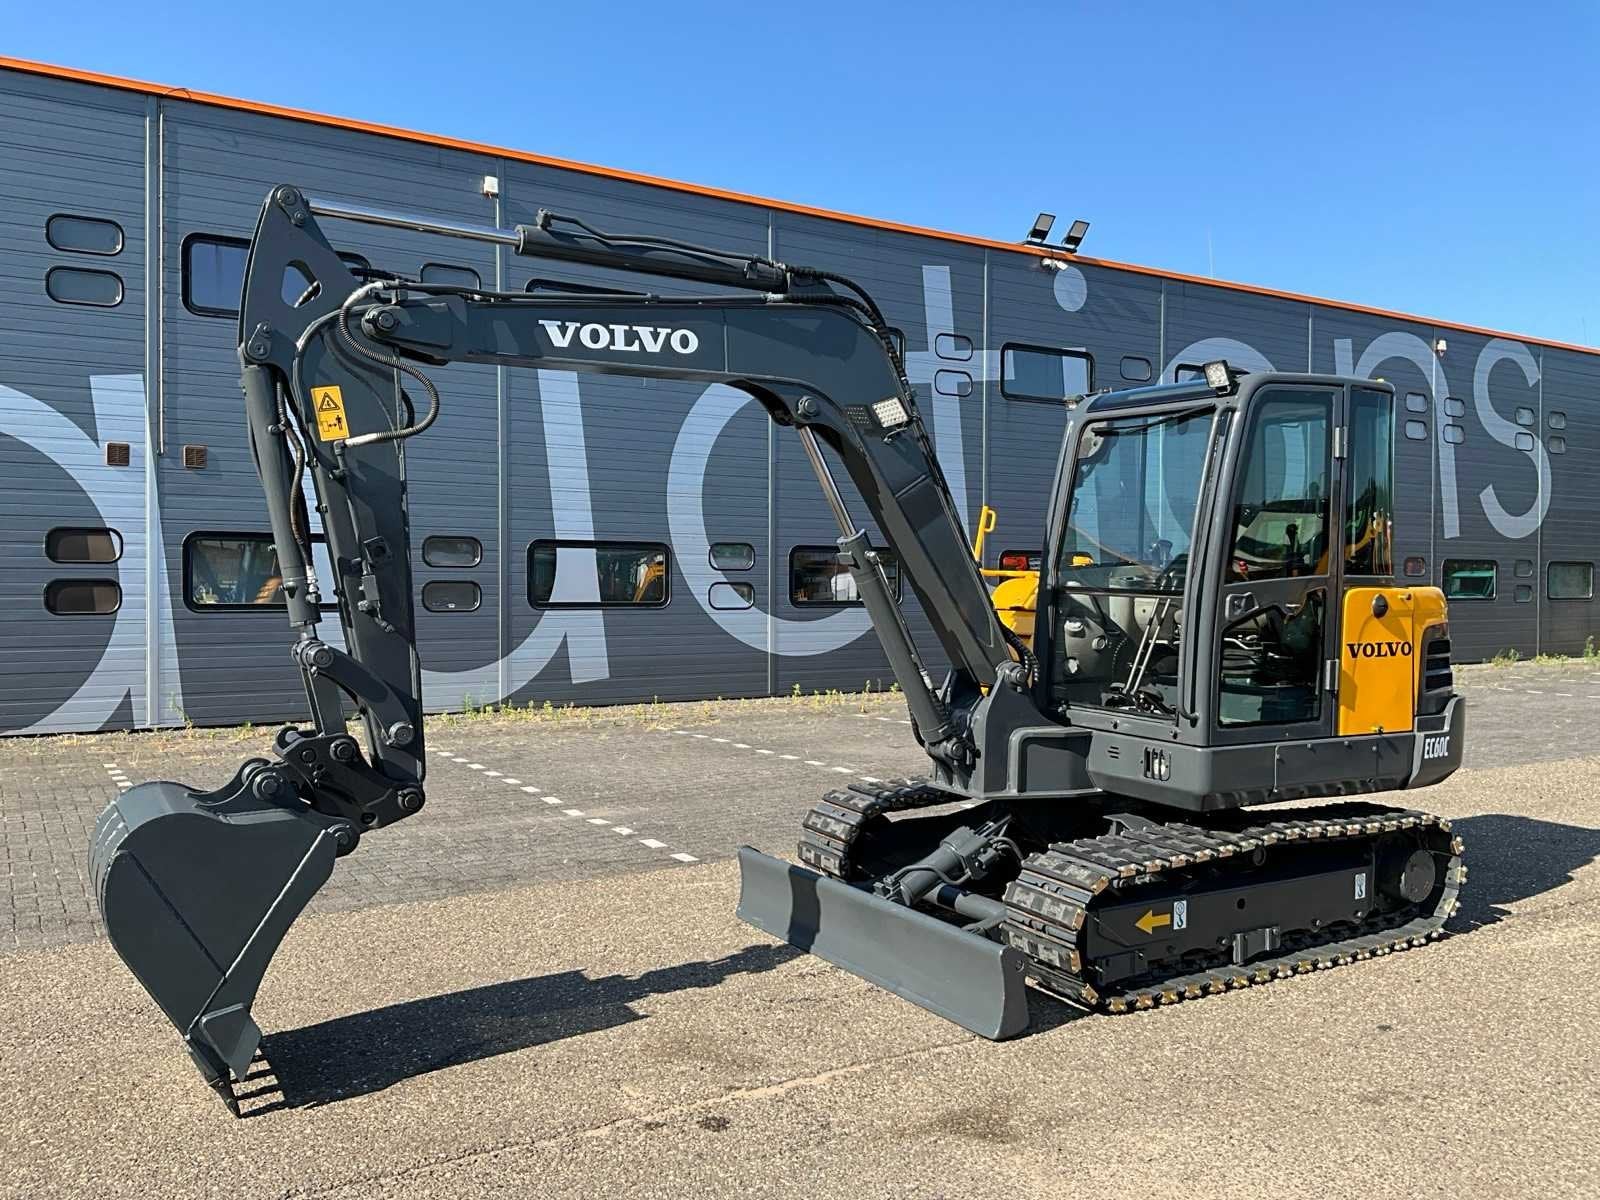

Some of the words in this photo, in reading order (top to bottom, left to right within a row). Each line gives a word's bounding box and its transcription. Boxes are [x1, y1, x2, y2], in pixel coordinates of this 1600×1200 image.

[538, 319, 699, 354] VOLVO
[1347, 641, 1413, 659] VOLVO
[1424, 735, 1450, 759] EC60C
